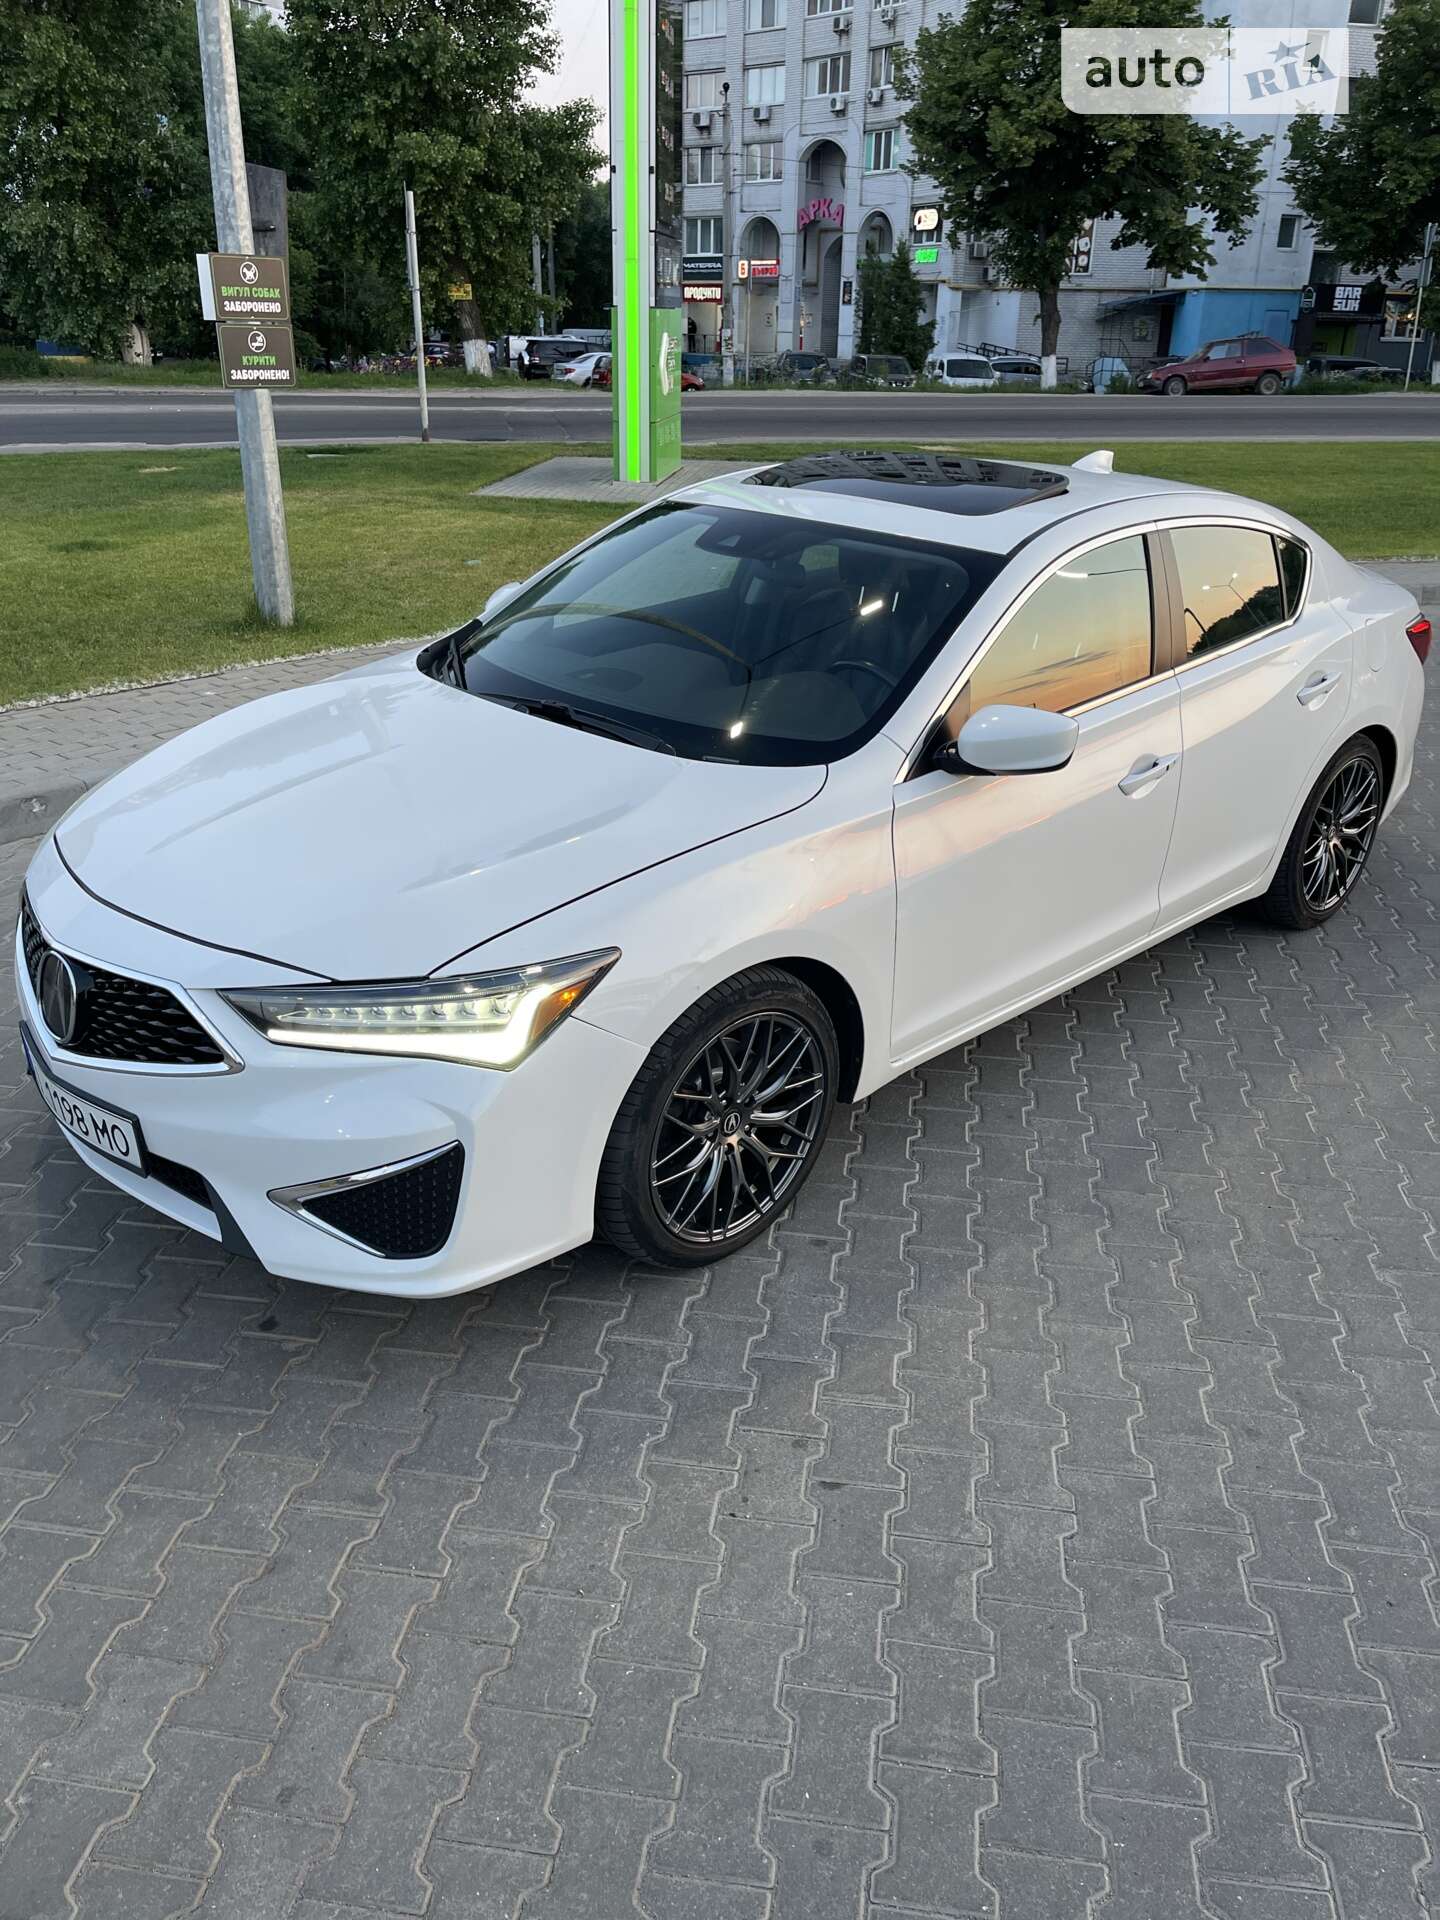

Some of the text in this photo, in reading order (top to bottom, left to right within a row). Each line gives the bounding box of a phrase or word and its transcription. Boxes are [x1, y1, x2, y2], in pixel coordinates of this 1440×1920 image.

[797, 197, 846, 231] АРКА
[220, 285, 281, 299] ВИГУЛ СОБАК
[1334, 286, 1362, 299] BAR
[223, 300, 281, 313] ЗАБОРОНЕНО
[1332, 299, 1360, 312] SUK
[242, 355, 276, 366] КУРИТИ
[230, 368, 290, 380] ЗАБОРОНЕНО!
[89, 1112, 131, 1157] MO
